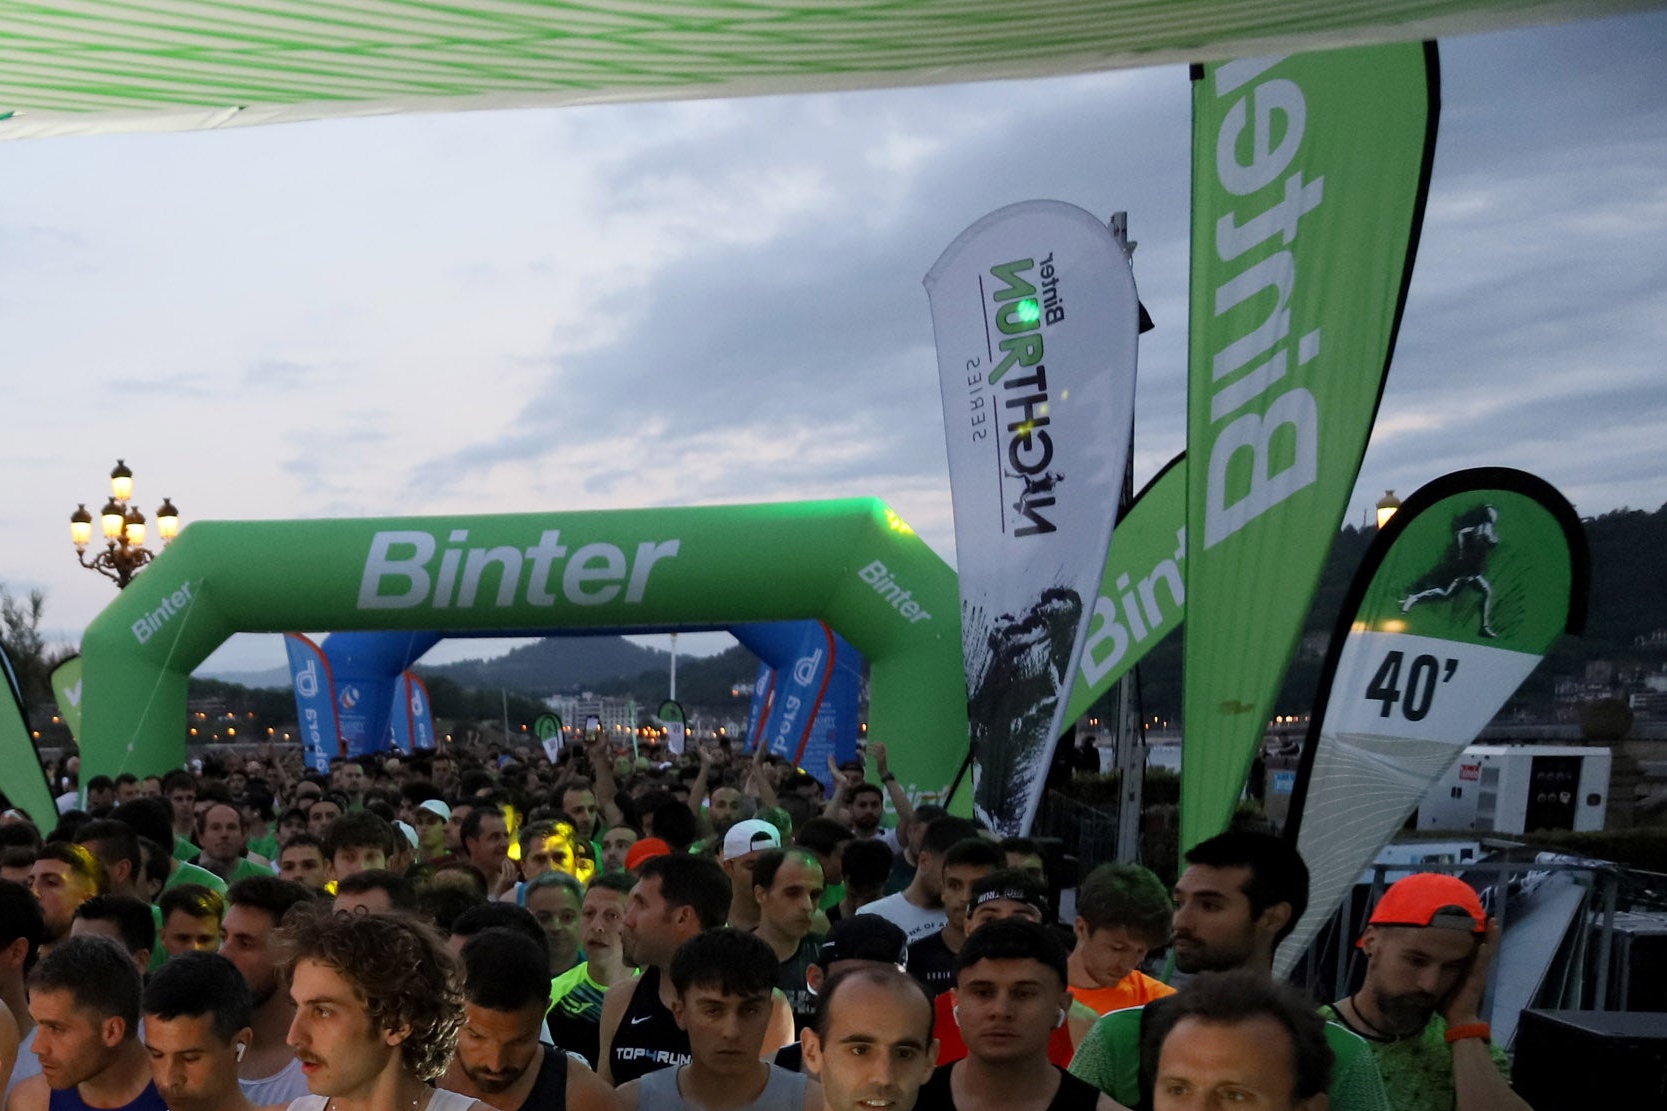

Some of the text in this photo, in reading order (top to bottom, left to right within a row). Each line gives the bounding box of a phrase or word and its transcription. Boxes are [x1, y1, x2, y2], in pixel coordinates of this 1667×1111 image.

[356, 529, 680, 609] Binter
[857, 559, 932, 623] Binter
[131, 580, 192, 645] Binter
